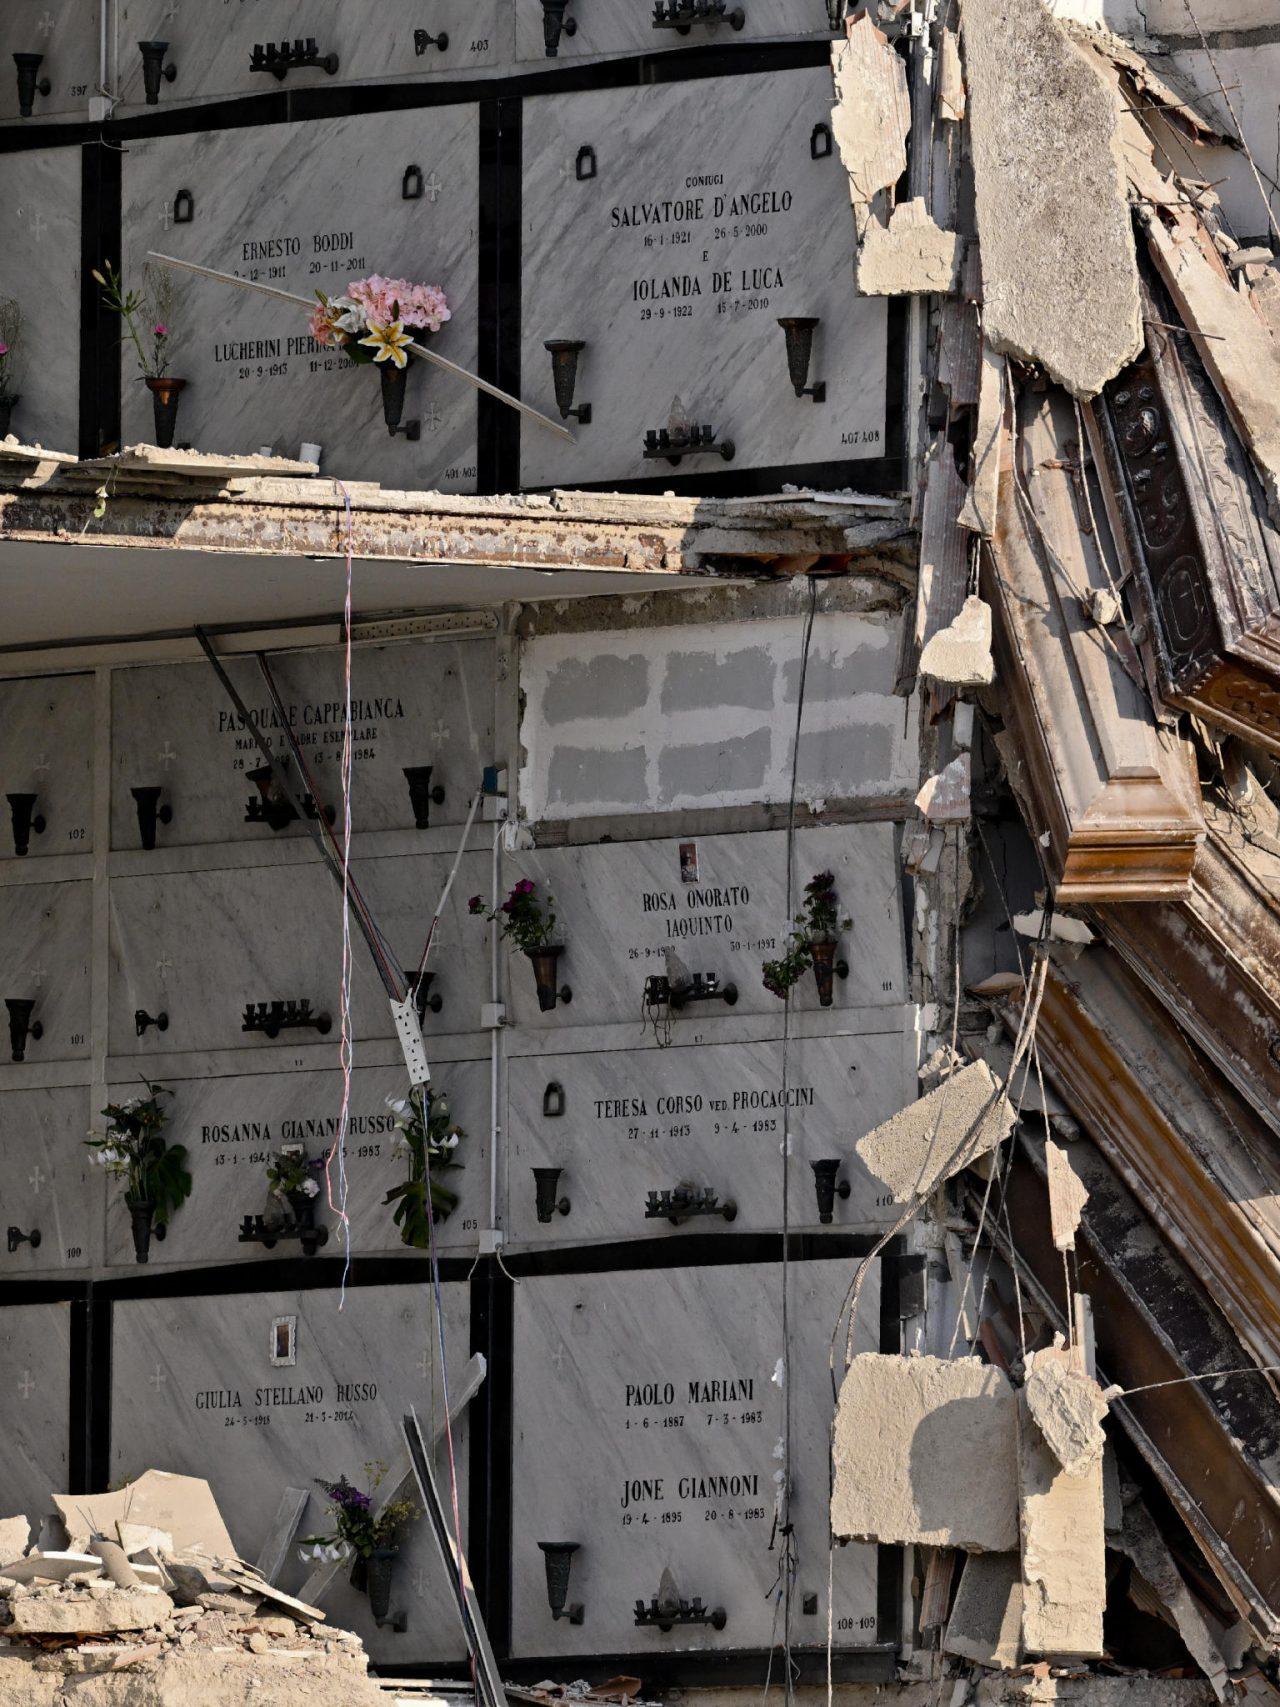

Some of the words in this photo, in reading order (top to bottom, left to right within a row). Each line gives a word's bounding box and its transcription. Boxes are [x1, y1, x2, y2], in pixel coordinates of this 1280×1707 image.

[470, 39, 489, 52] 403
[71, 85, 88, 97] 397
[685, 174, 724, 189] CONIUGI
[611, 198, 704, 228] SALVATORE
[713, 190, 793, 218] D'ANGELO
[242, 237, 300, 261] ERNESTO
[313, 232, 354, 253] BODDI
[702, 250, 709, 262] E
[633, 275, 702, 301] IOLANDA
[711, 271, 732, 294] DE
[741, 267, 784, 291] LUCA
[215, 339, 281, 362] LUCHERINI
[287, 336, 335, 356] PIERI
[219, 705, 297, 732] PASQUAE
[235, 736, 272, 750] MARIO
[292, 732, 318, 746] ADRE
[323, 727, 378, 744] ESEMLARE
[68, 828, 85, 840] 102
[642, 892, 677, 912] ROSA
[687, 886, 750, 909] ONORATO
[666, 914, 733, 940] IAQUINTO
[882, 980, 892, 991] 111
[71, 1033, 84, 1045] 101
[594, 1098, 648, 1119] TERESA
[656, 1094, 703, 1115] CORSO
[732, 1087, 814, 1110] PROCACCINI
[201, 1120, 271, 1144] ROSANNA
[350, 1114, 395, 1135] RUSSO
[876, 1194, 893, 1206] 110
[462, 1219, 478, 1230] 105
[67, 1247, 82, 1259] 100
[195, 1390, 242, 1409] GIULIA
[254, 1386, 323, 1406] STELLANO
[336, 1383, 377, 1402] RUSSO
[625, 1382, 675, 1406] PAOLO
[688, 1379, 753, 1403] MARIANI
[620, 1478, 664, 1509] JONE
[678, 1474, 759, 1499] GIANNONI
